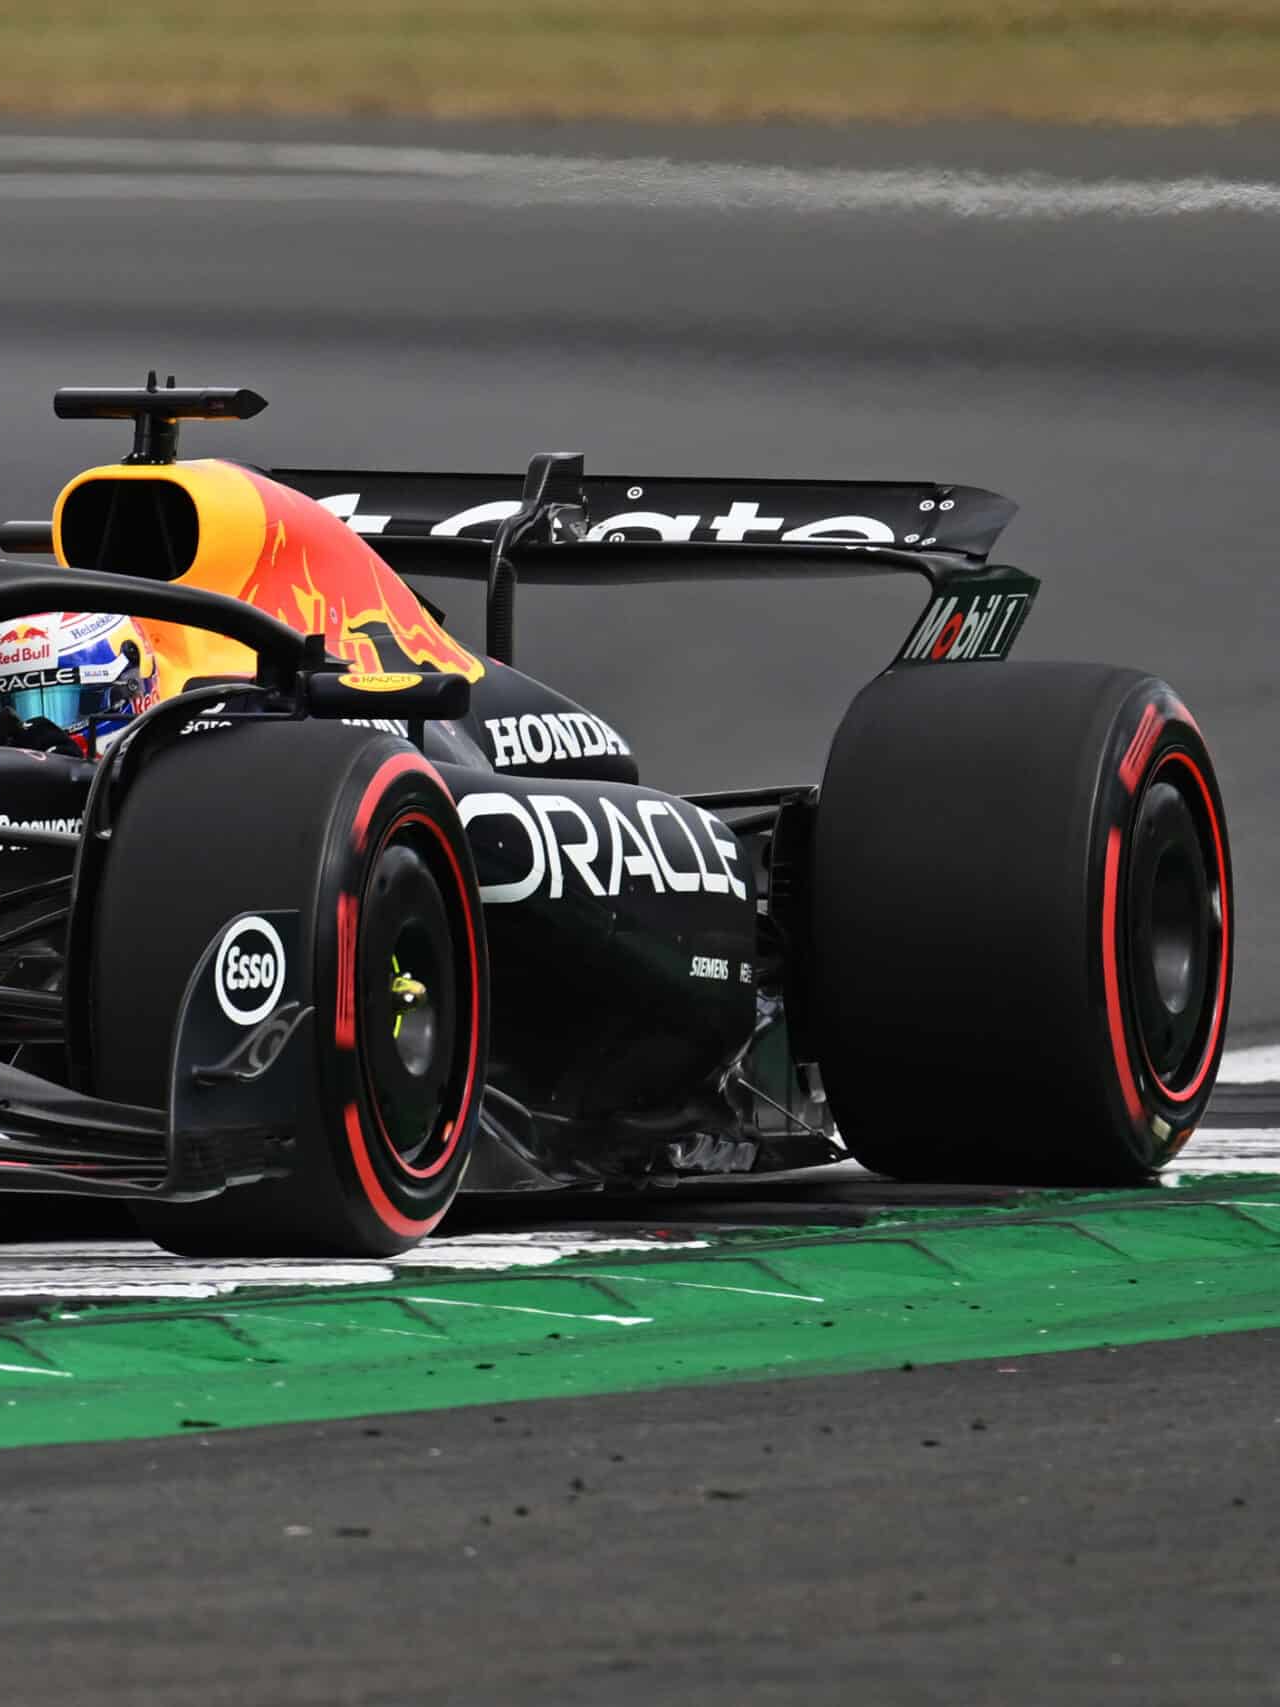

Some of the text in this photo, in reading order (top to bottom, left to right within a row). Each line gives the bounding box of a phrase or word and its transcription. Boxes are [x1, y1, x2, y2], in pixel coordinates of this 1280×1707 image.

[22, 644, 50, 662] Bull
[903, 594, 1003, 661] Mobil
[485, 712, 631, 768] HONDA
[456, 792, 747, 904] ORACLE
[226, 945, 275, 990] Esso
